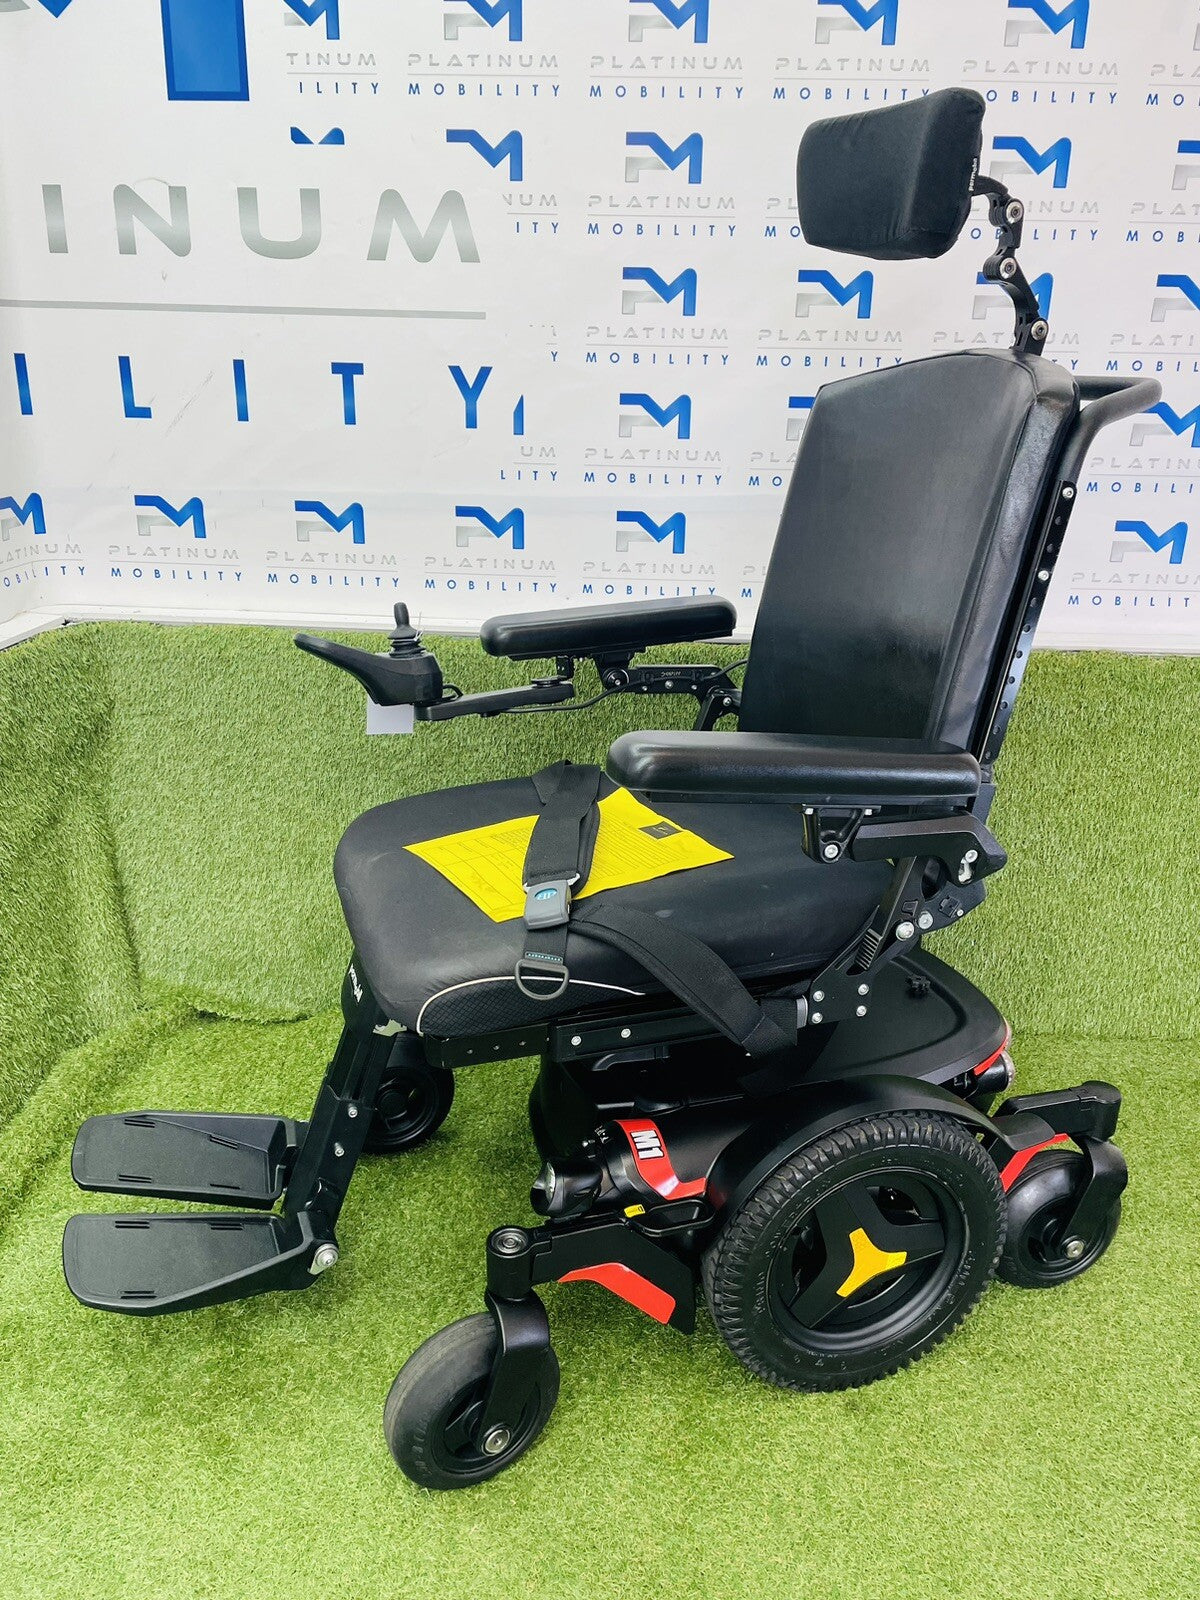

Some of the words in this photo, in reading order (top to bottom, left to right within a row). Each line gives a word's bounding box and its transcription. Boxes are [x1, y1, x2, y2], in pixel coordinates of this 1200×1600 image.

[407, 53, 559, 68] PLATINUM
[590, 55, 743, 71] PLATINUM
[774, 57, 930, 73] PLATINUM
[962, 59, 1119, 76] PLATINUM
[408, 82, 559, 97] MOBILITY
[589, 85, 743, 99] MOBILITY
[587, 194, 736, 210] PLATINUM
[587, 223, 736, 237] MOBILITY
[586, 325, 729, 341] PLATINUM
[758, 329, 903, 343] PLATINUM
[585, 352, 729, 366] MOBILITY
[584, 447, 722, 462] PLATINUM
[583, 471, 722, 486] MOBILITY
[108, 544, 240, 560] PLATINUM
[265, 550, 397, 566] PLATINUM
[423, 556, 556, 571] PLATINUM
[582, 561, 716, 575] PLATINUM
[111, 567, 242, 582] MOBILITY
[267, 573, 399, 588] MOBILITY
[424, 579, 557, 593] MOBILITY
[582, 583, 716, 599] MOBILITY
